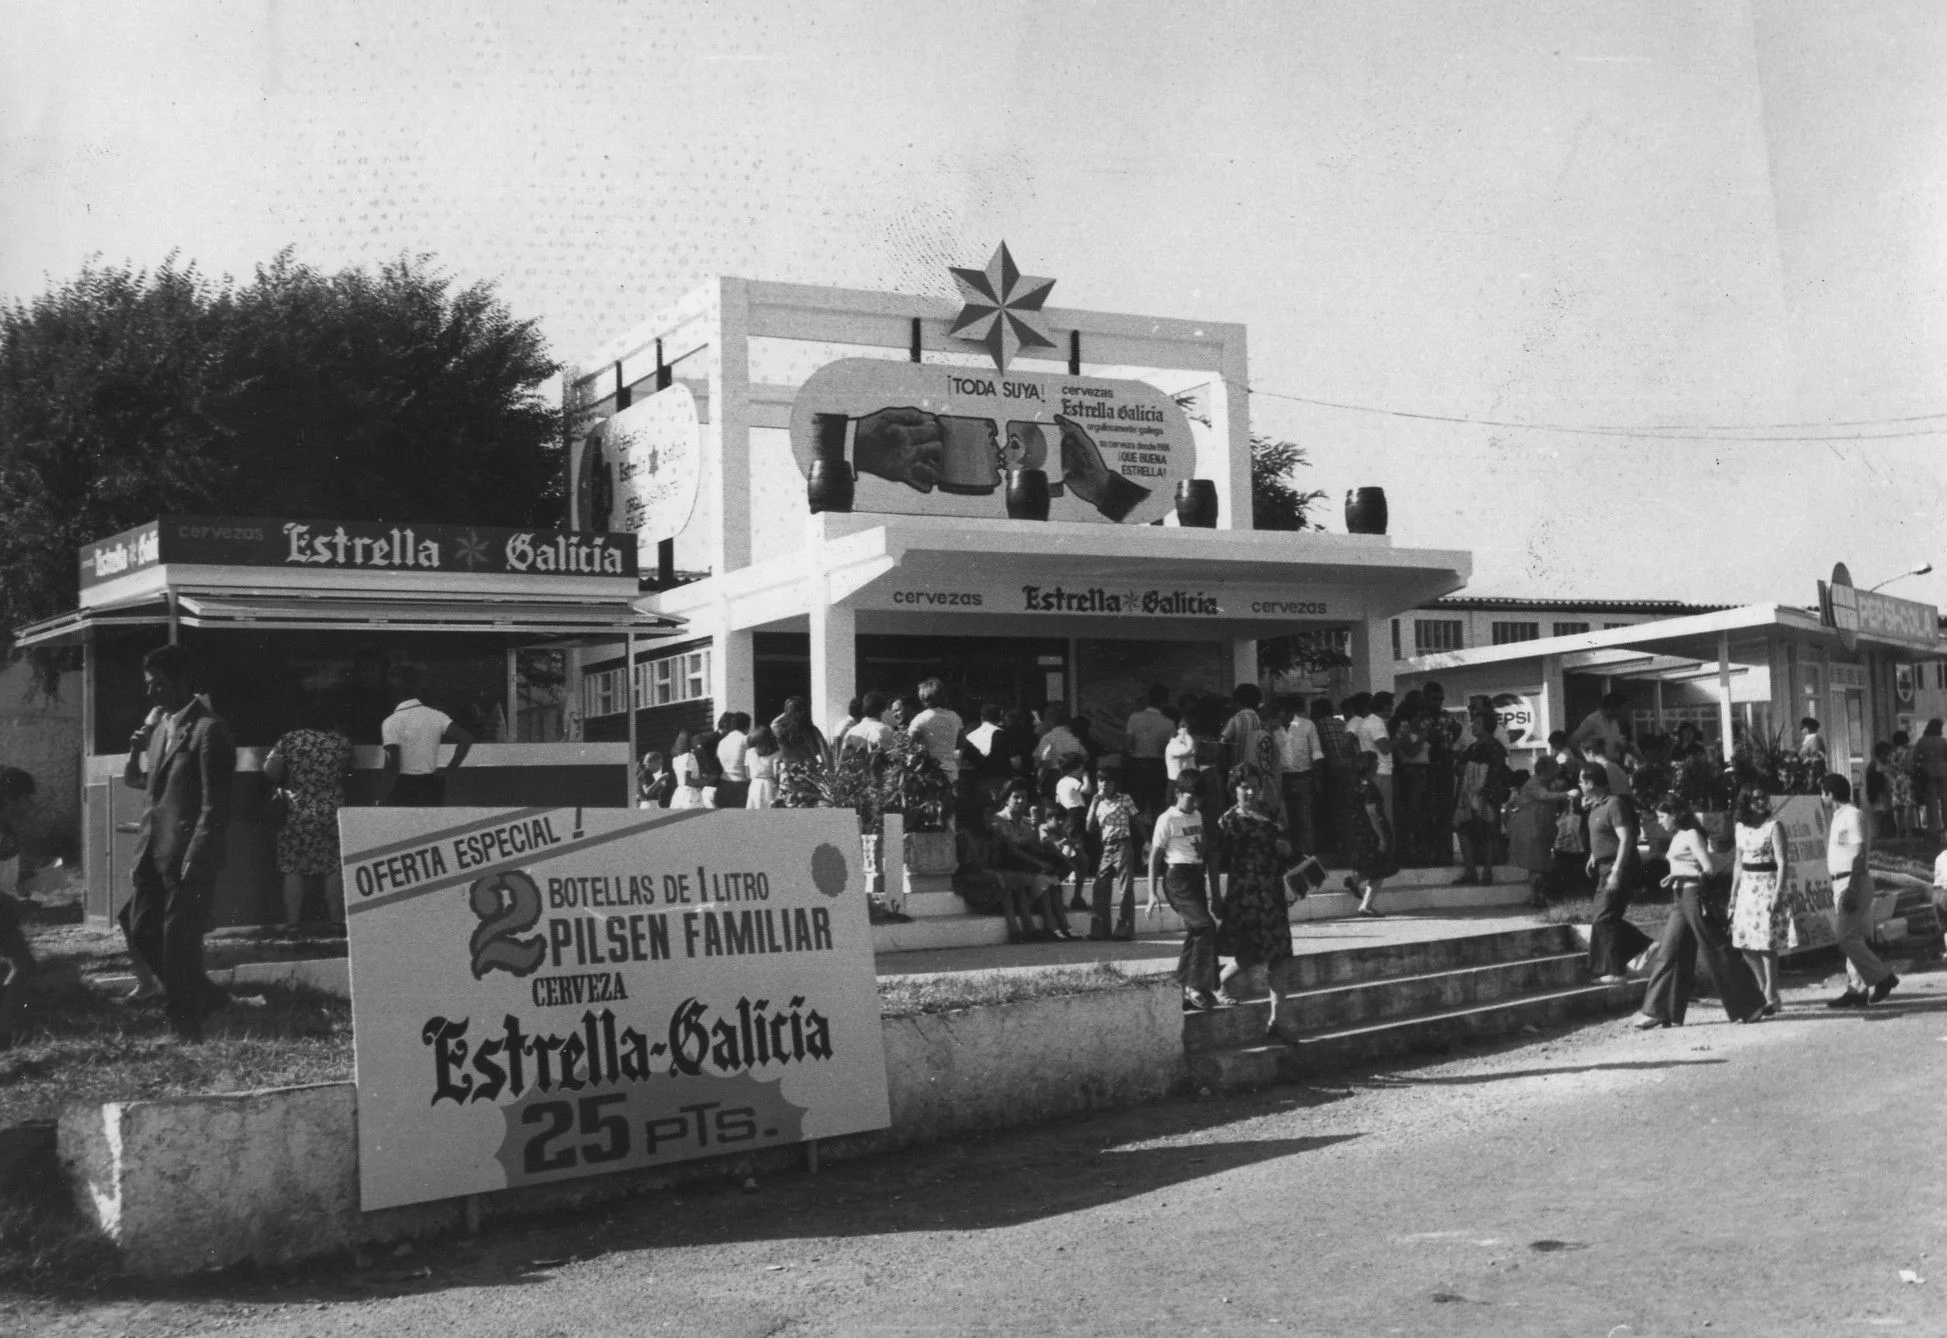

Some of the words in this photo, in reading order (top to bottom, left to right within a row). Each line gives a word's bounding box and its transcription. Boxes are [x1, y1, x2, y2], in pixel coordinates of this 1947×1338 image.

[1002, 381, 1046, 403] SUYA!
[1061, 386, 1114, 399] cervezas
[1061, 398, 1114, 420] Estrella
[1117, 404, 1164, 422] Galicia
[178, 525, 264, 541] cervezas
[282, 521, 441, 569] Estrella
[505, 532, 623, 574] Galicia
[892, 590, 984, 607] cervezas
[1022, 585, 1122, 613] Estrella
[1142, 589, 1218, 615] Galicia
[1251, 600, 1328, 615] cervezas
[1496, 711, 1531, 725] EPSI
[355, 845, 448, 897] OFERTA
[453, 816, 561, 869] ESPECIAL
[548, 874, 655, 909] BOTELLAS
[663, 874, 692, 904] DE
[697, 866, 708, 901] 1
[712, 871, 770, 902] LITRO
[468, 869, 548, 981] 2
[549, 913, 671, 967] PILSEN
[683, 906, 834, 958] FAMILIAR
[532, 971, 629, 1007] CERVEZA
[520, 1092, 631, 1175] 25
